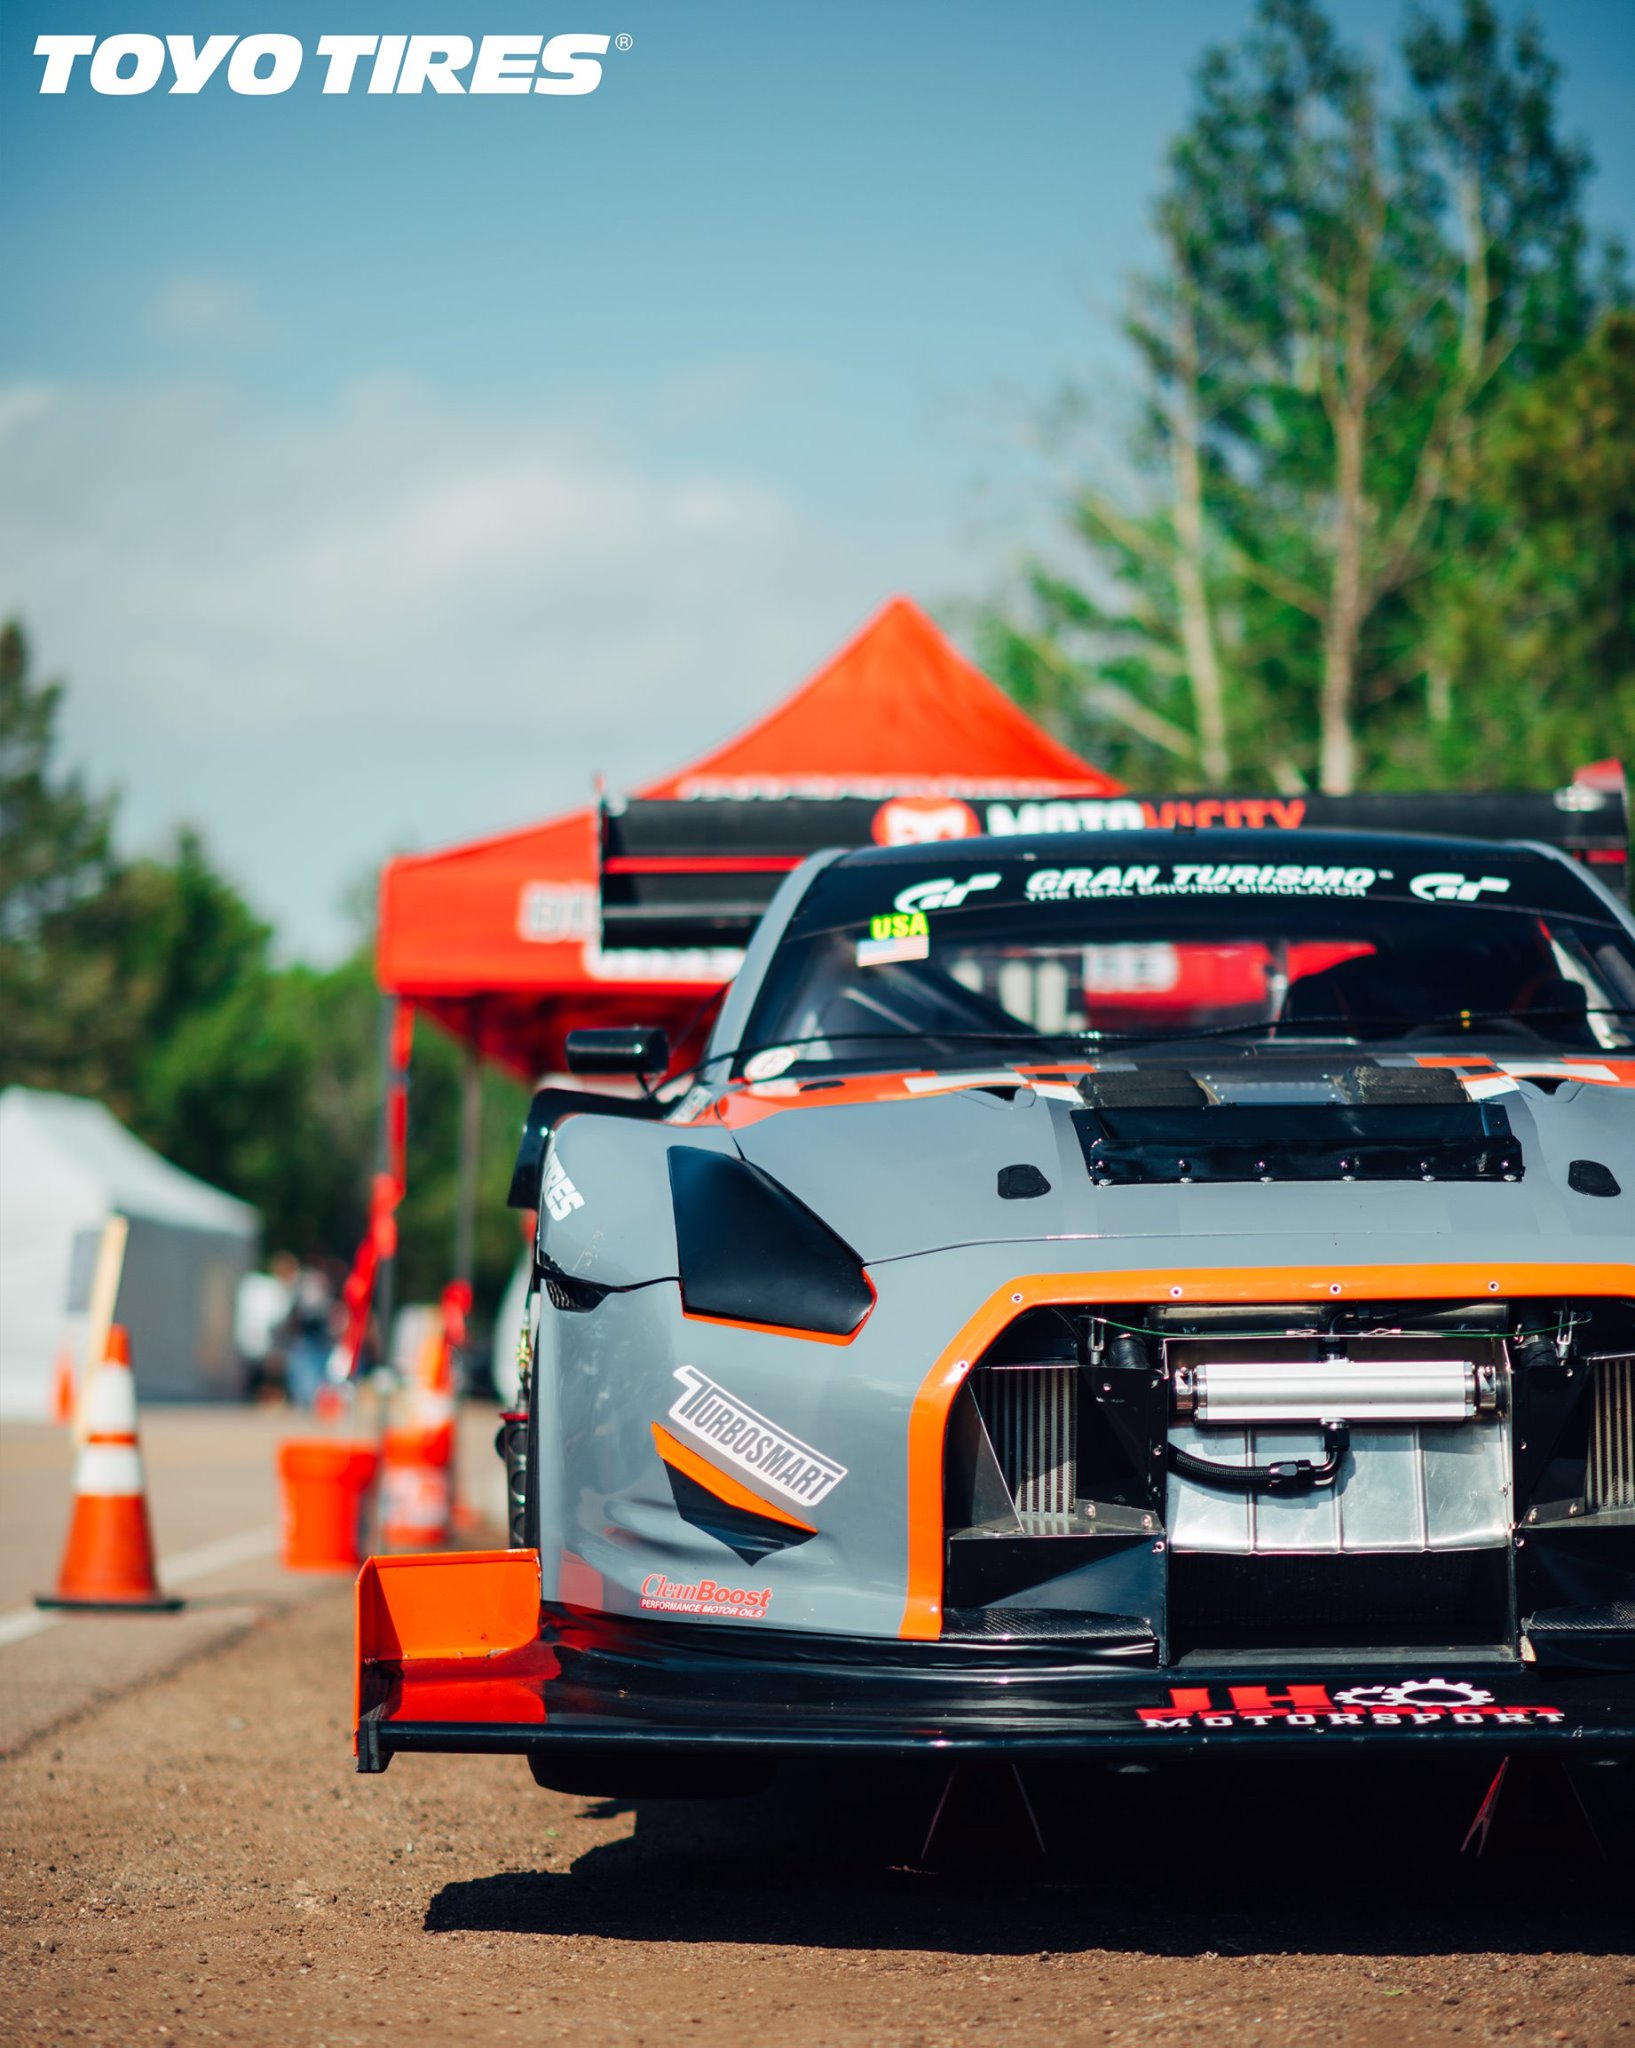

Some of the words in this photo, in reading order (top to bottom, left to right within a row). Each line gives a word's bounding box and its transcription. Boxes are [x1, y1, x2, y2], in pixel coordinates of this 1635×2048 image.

[1026, 865, 1160, 892] GRAN
[1025, 890, 1070, 901] THE
[1074, 887, 1134, 899] REAL
[1137, 883, 1231, 896] DRIVING
[1235, 884, 1366, 897] SIMULATOR
[870, 912, 929, 941] USA
[676, 1367, 846, 1502] TURBOSMART
[641, 1573, 772, 1608] CleanBoost
[641, 1598, 701, 1613] PERFORMANCE
[702, 1604, 737, 1616] MOTOR
[739, 1608, 764, 1618] OILS
[1160, 1684, 1334, 1710] JH
[1144, 1713, 1565, 1728] MOTORSPORT
